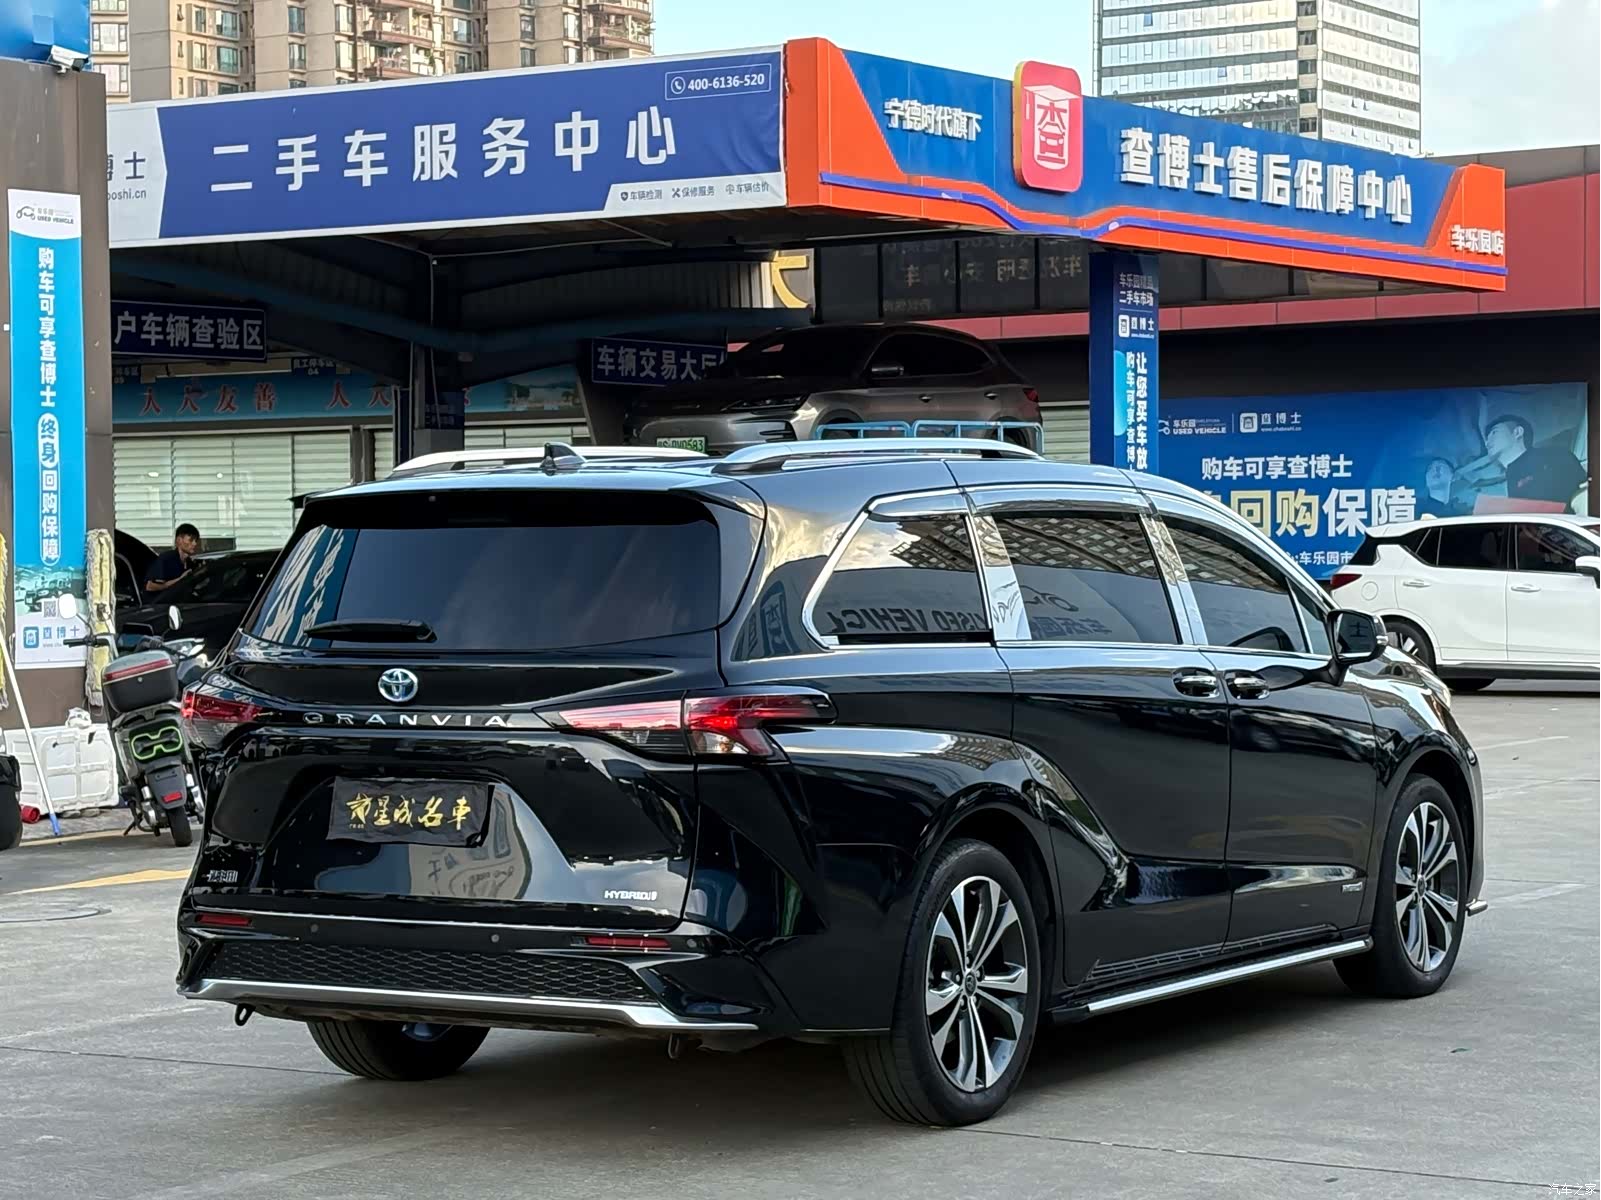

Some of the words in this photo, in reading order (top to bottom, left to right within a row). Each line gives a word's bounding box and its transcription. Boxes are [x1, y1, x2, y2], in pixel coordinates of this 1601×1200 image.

[688, 73, 765, 91] 400-6136-520
[884, 97, 983, 141] 宁德时代旗下
[210, 105, 677, 192] 二手车服务中心
[630, 189, 663, 201] 车辆检测
[682, 185, 715, 197] 保修服务
[735, 181, 770, 193] 车辆估价
[1120, 127, 1413, 224] 查博士售后保障中心
[1450, 224, 1504, 255] 车乐园店
[38, 247, 57, 407] 购车可享查博士
[114, 310, 264, 350] 户车辆查验区
[597, 345, 725, 380] 车辆交易大厅
[1201, 453, 1353, 480] 购车可享查博士
[1203, 486, 1417, 538] 回购保障
[303, 712, 509, 728] GRANVIA
